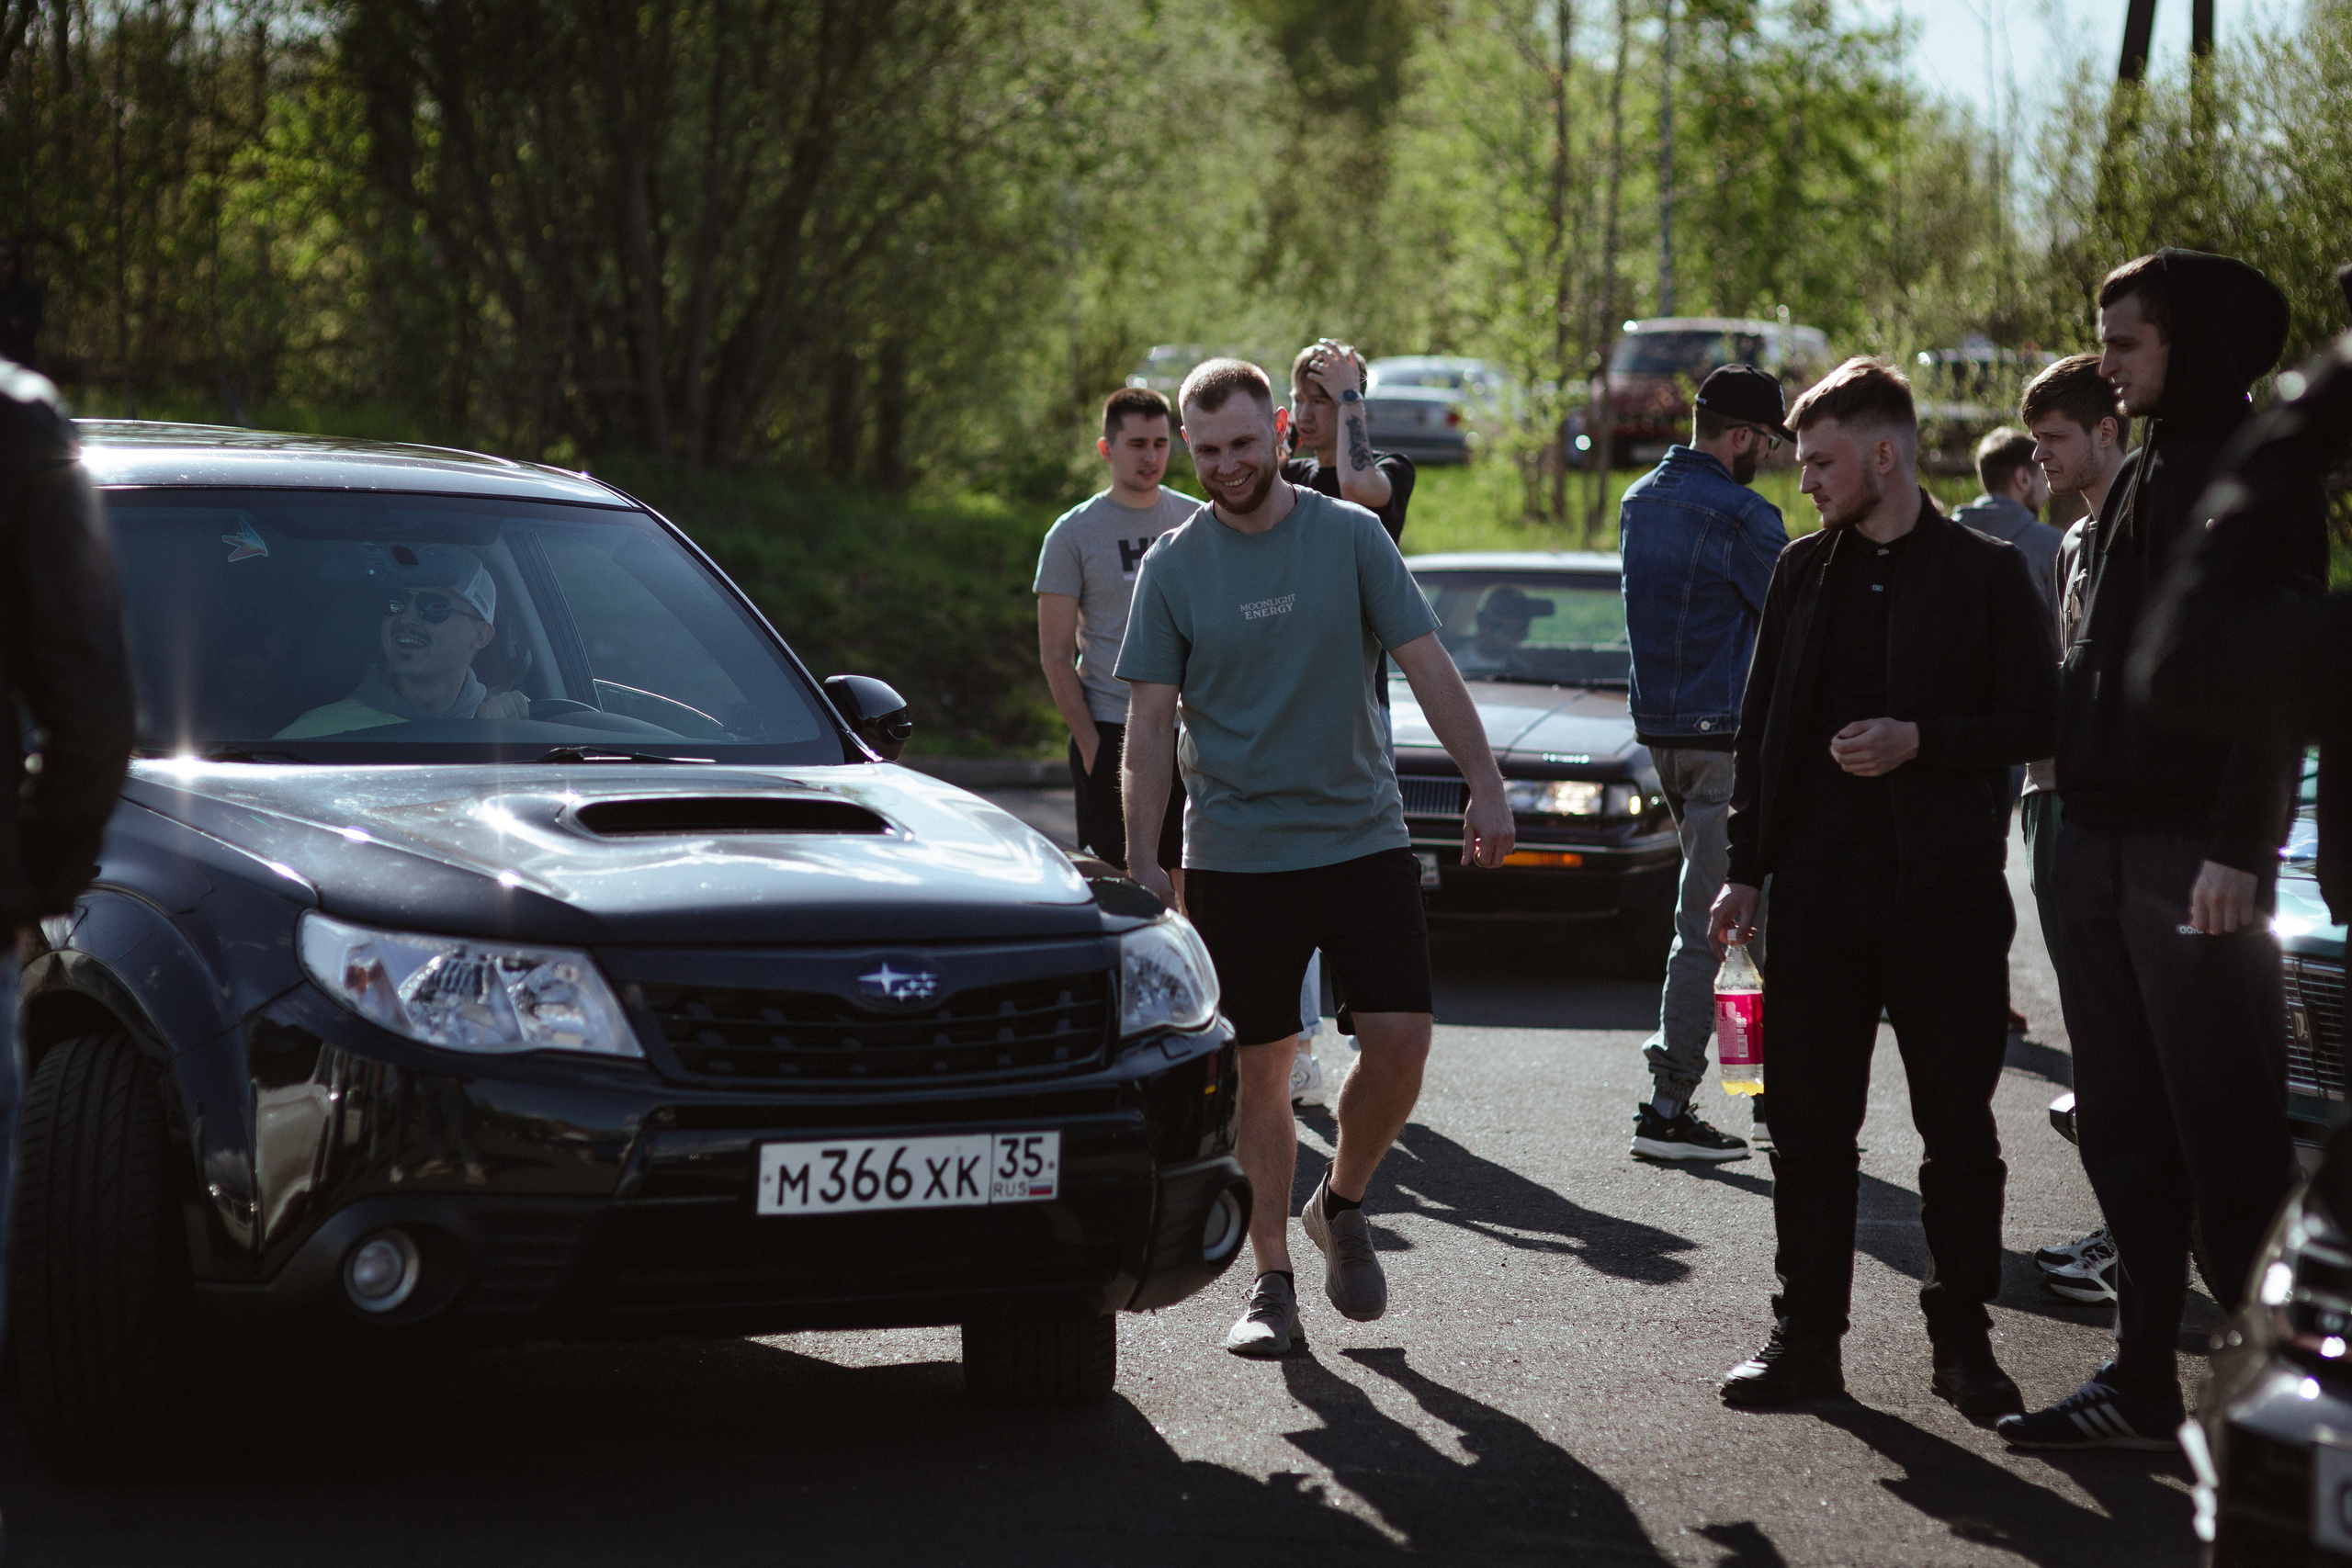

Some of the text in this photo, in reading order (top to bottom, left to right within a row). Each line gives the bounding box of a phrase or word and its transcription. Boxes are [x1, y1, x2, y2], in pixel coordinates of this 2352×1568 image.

[1239, 593, 1295, 612] MOONLIGHT
[1245, 602, 1294, 620] ENERGY
[999, 1137, 1044, 1179] 35
[992, 1180, 1028, 1198] RUS
